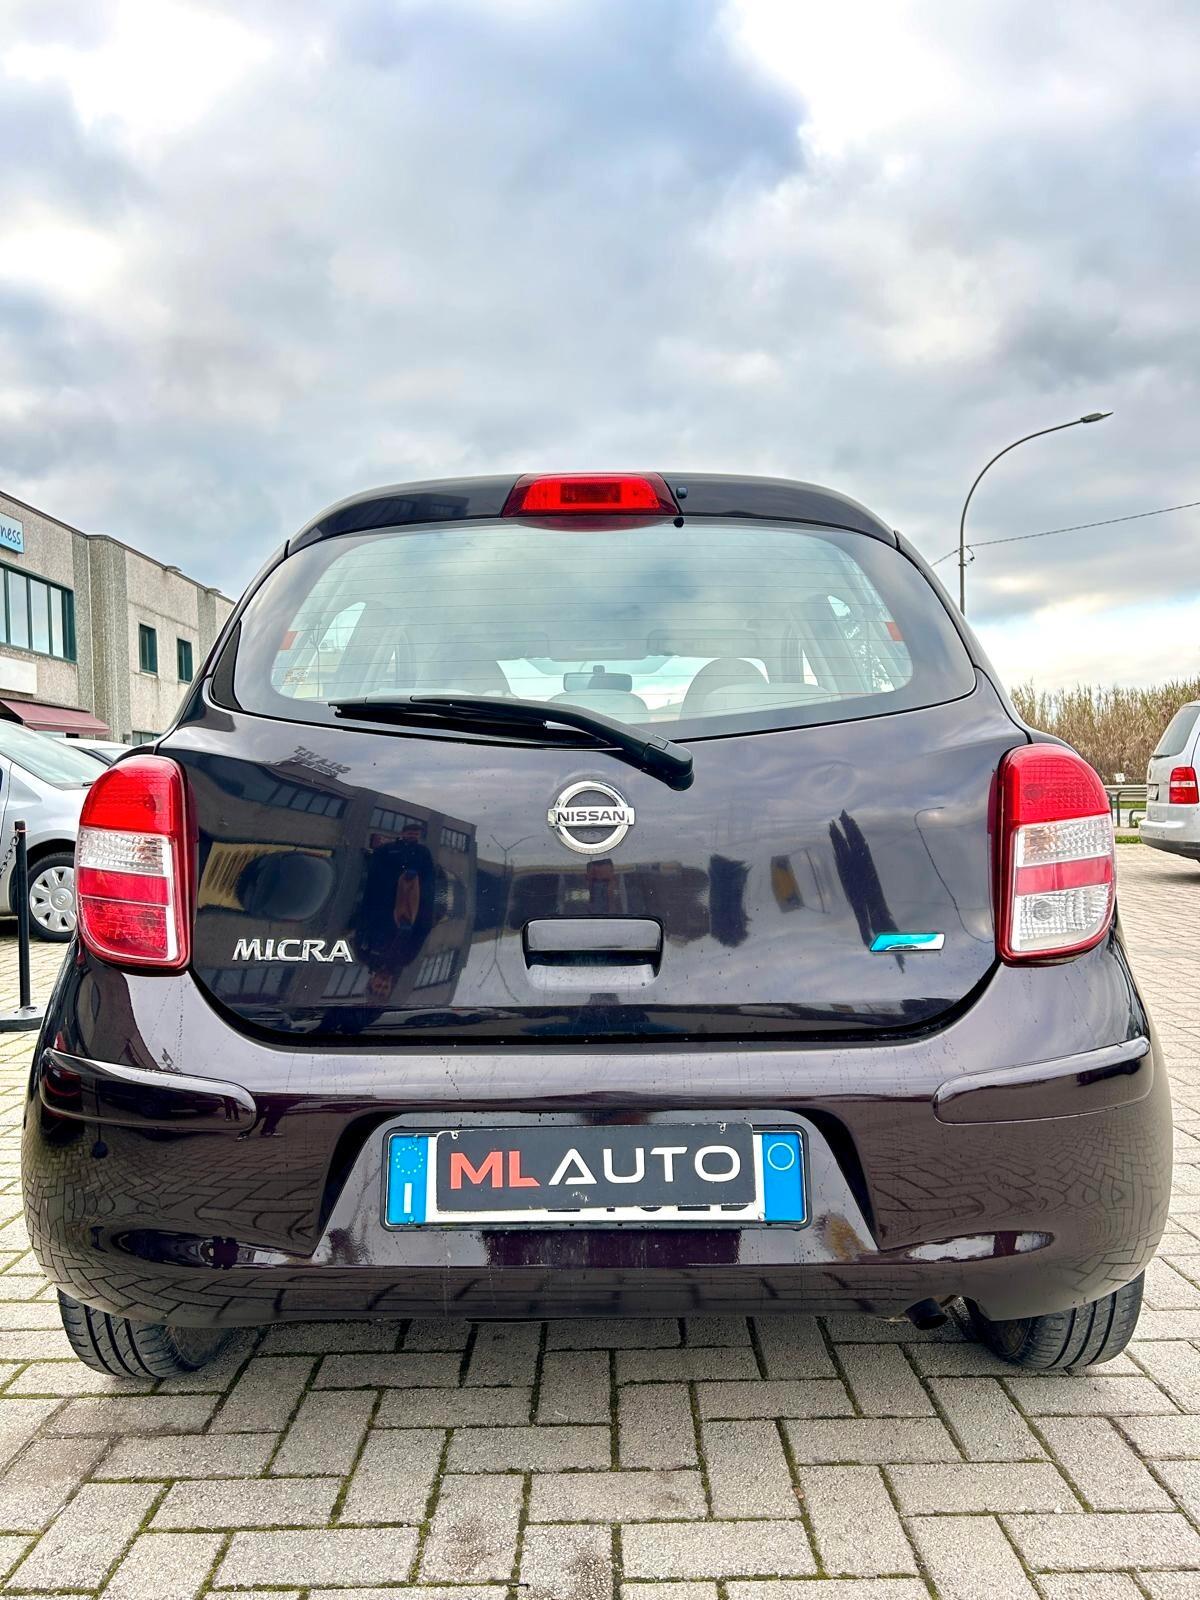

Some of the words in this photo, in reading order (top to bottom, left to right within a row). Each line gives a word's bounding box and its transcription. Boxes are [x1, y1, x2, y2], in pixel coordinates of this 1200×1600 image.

[1, 525, 21, 545] ness
[557, 811, 625, 822] NISSAN
[231, 938, 354, 963] MICRA
[450, 1151, 540, 1190] ML
[548, 1145, 741, 1186] AUTO
